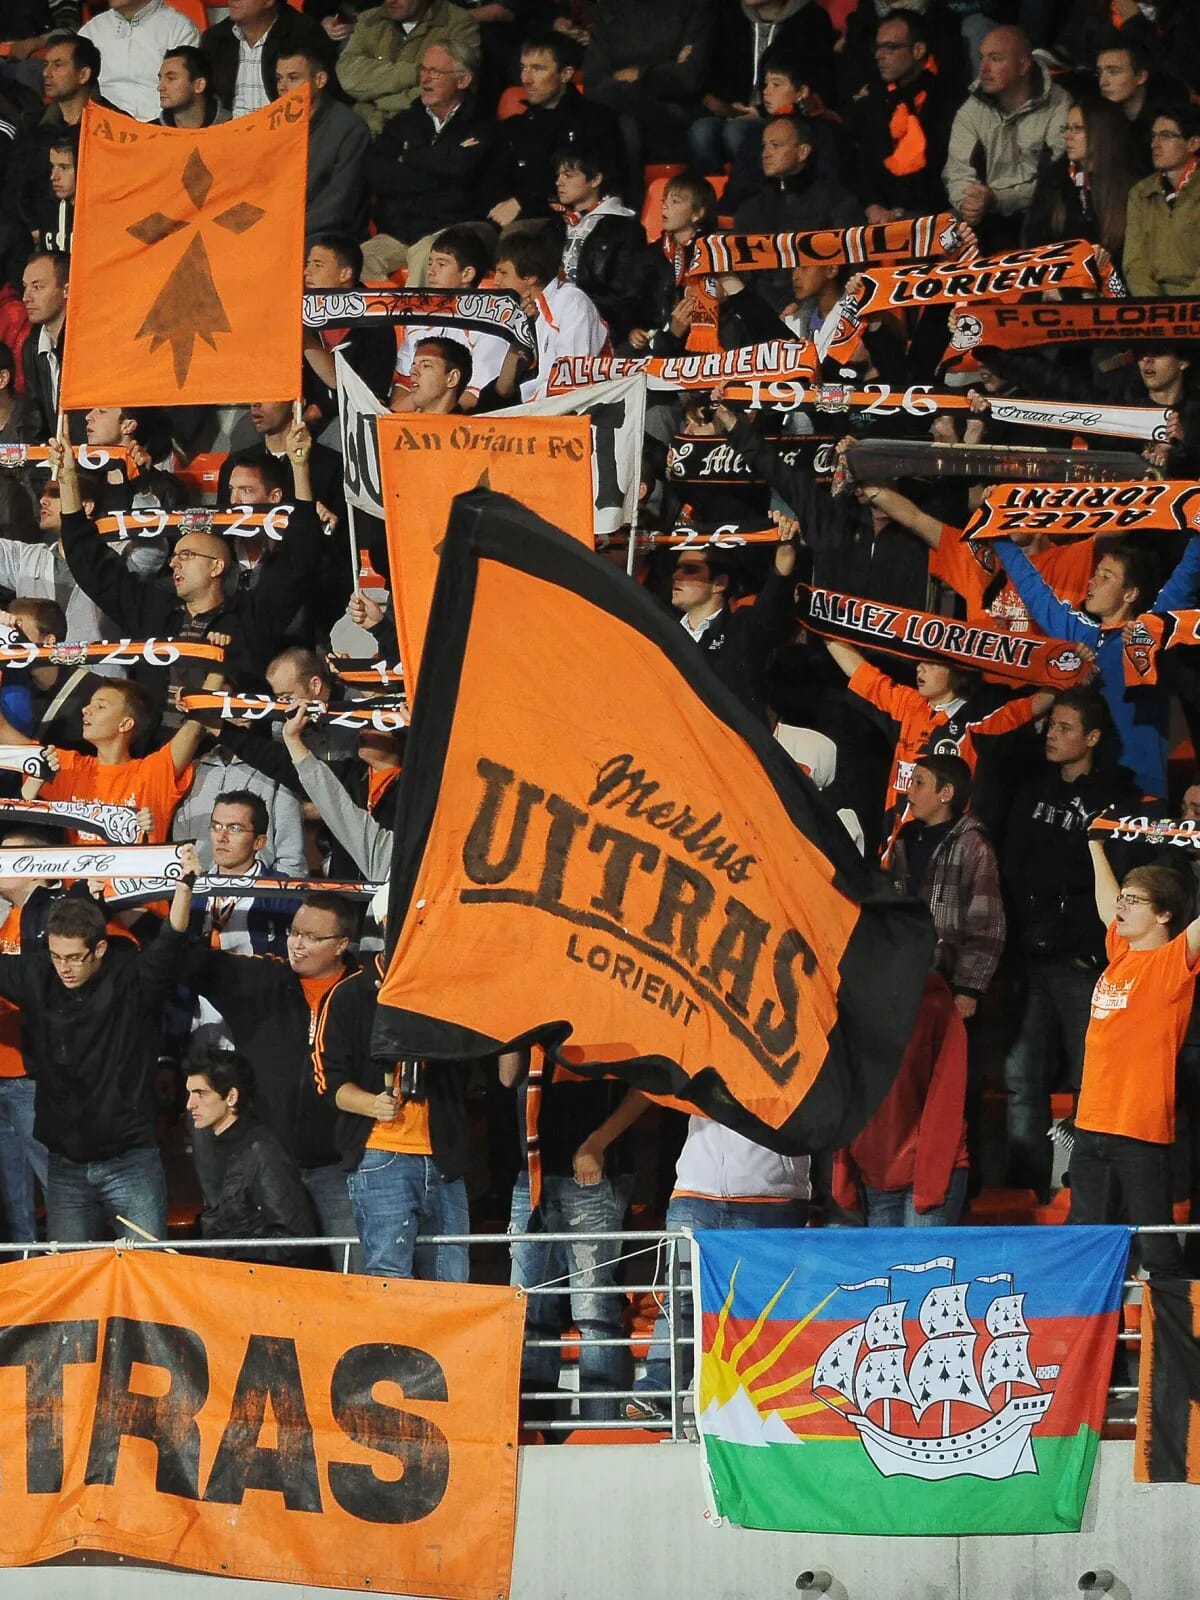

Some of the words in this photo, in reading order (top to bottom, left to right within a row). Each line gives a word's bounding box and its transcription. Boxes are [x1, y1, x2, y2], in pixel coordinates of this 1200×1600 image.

[890, 261, 1073, 305] LORIENT
[994, 308, 1074, 327] F.C.
[393, 427, 442, 452] An
[450, 426, 536, 456] Oriant
[548, 436, 585, 462] FC
[998, 485, 1172, 509] LORIENT
[998, 508, 1157, 530] ALLEZ
[809, 589, 903, 640] ALLEZ
[902, 614, 1046, 671] LORIENT
[588, 753, 763, 885] Merlus
[11, 856, 70, 874] Oriant
[71, 854, 117, 872] FC
[461, 756, 820, 1058] ULTRAS
[565, 933, 701, 1028] LORIENT
